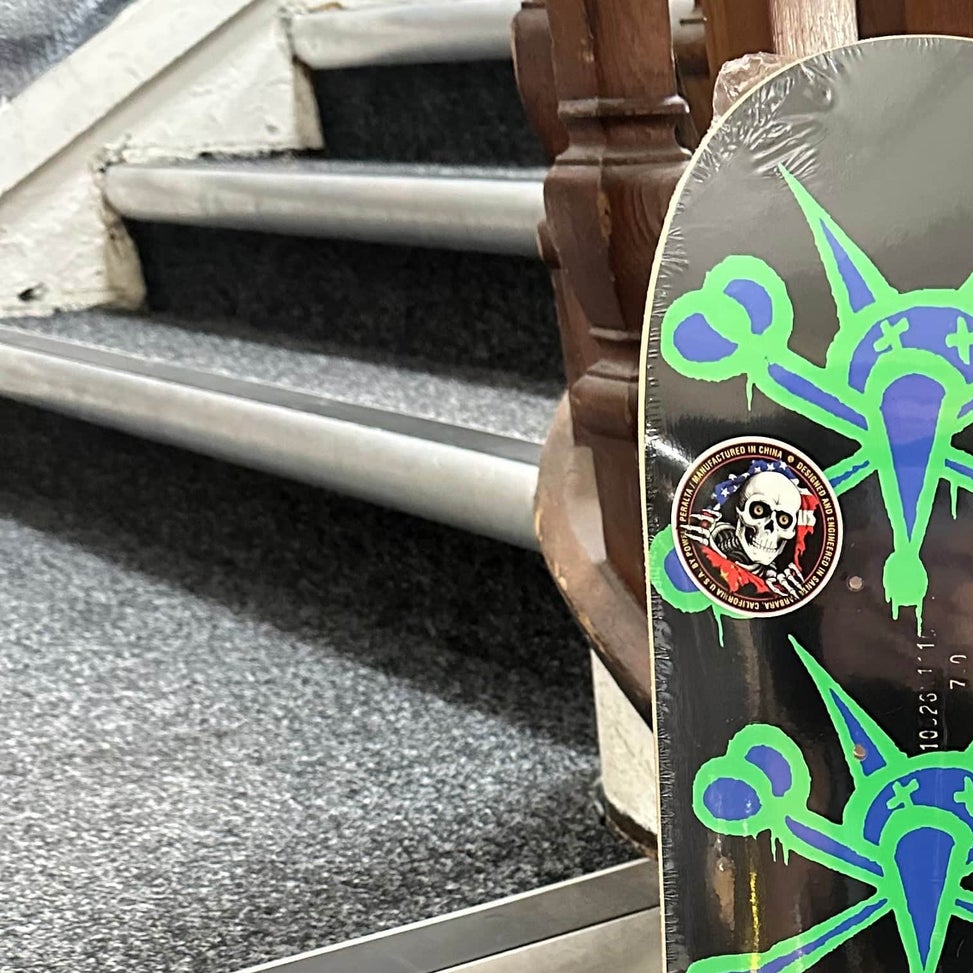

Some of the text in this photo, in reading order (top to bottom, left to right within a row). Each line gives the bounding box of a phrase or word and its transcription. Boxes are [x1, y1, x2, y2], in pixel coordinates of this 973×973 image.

[747, 445, 757, 454] IN
[758, 446, 783, 459] CHINA
[692, 446, 746, 485] MANUFACTURED
[796, 463, 827, 500] DESIGNED
[679, 488, 694, 522] PERALTA
[821, 498, 834, 514] AND
[821, 516, 837, 567] ENGINEERED
[688, 558, 699, 570] BY
[816, 566, 826, 577] IN
[716, 589, 760, 610] CALIFORNIA
